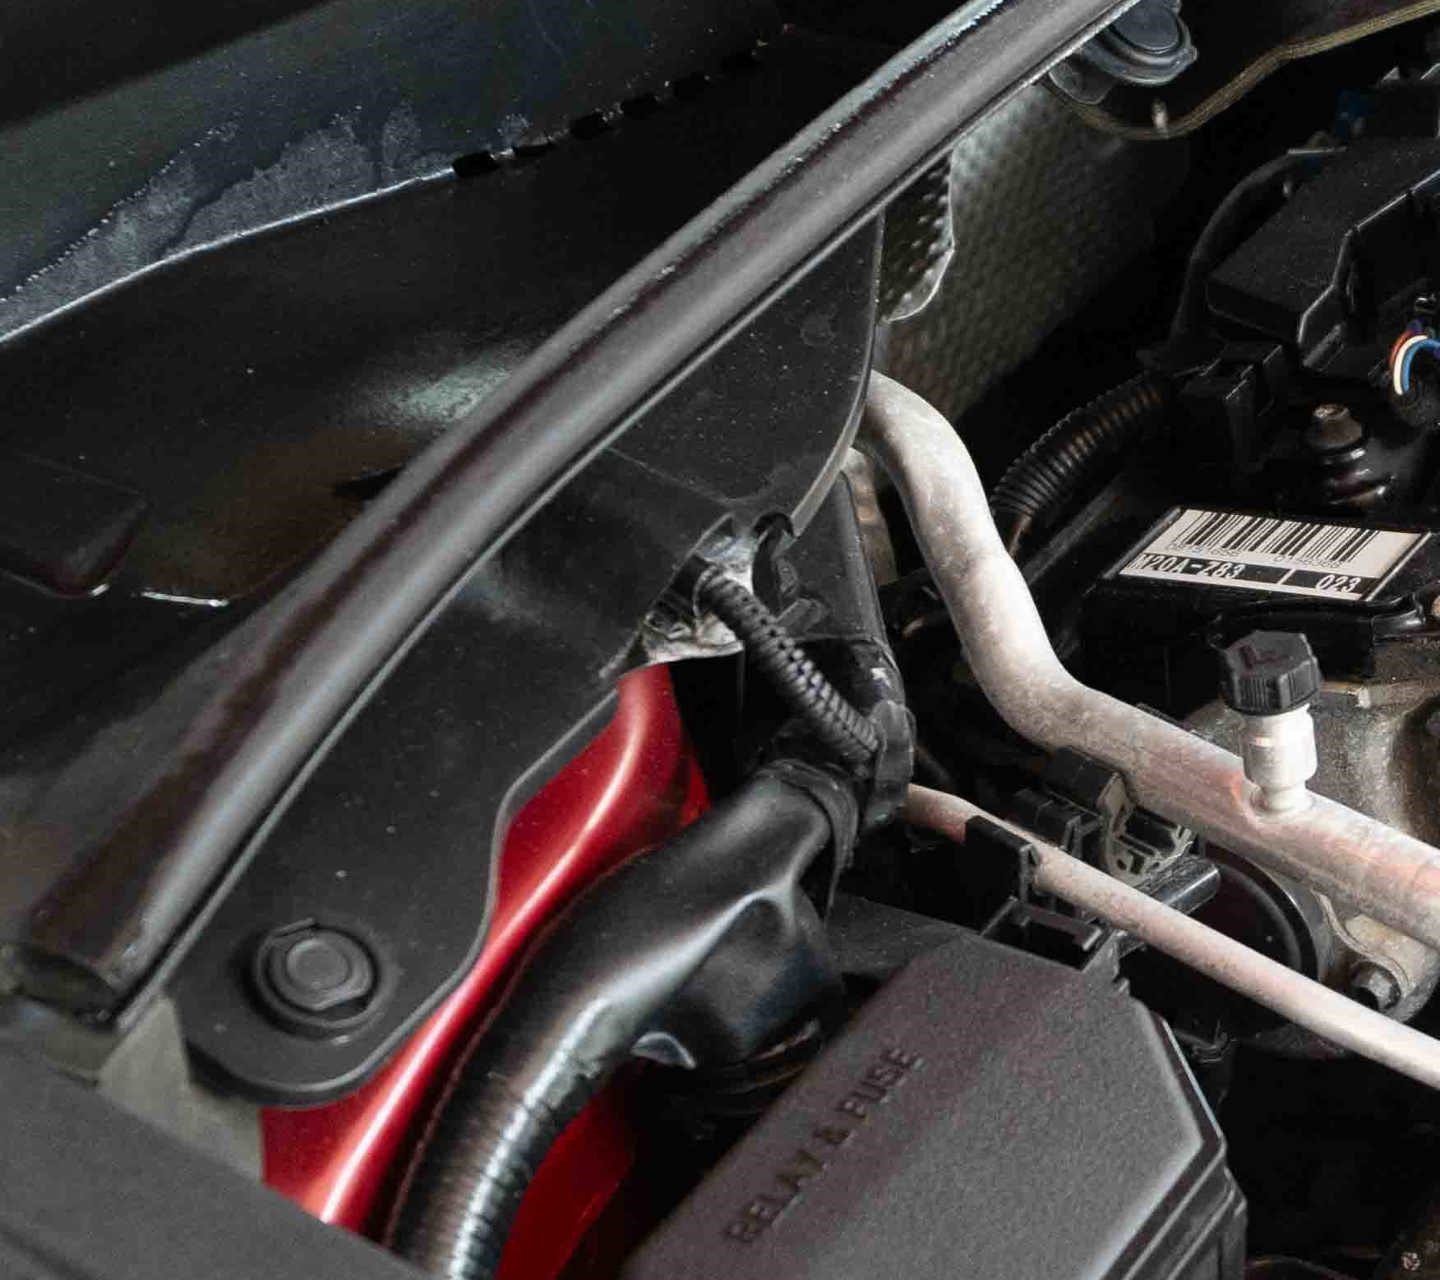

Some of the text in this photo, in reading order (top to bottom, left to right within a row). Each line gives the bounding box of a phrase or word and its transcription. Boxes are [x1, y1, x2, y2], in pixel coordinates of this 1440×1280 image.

[1316, 575, 1362, 594] 023
[723, 1148, 828, 1243] RELAY
[833, 1047, 925, 1123] FUSE
